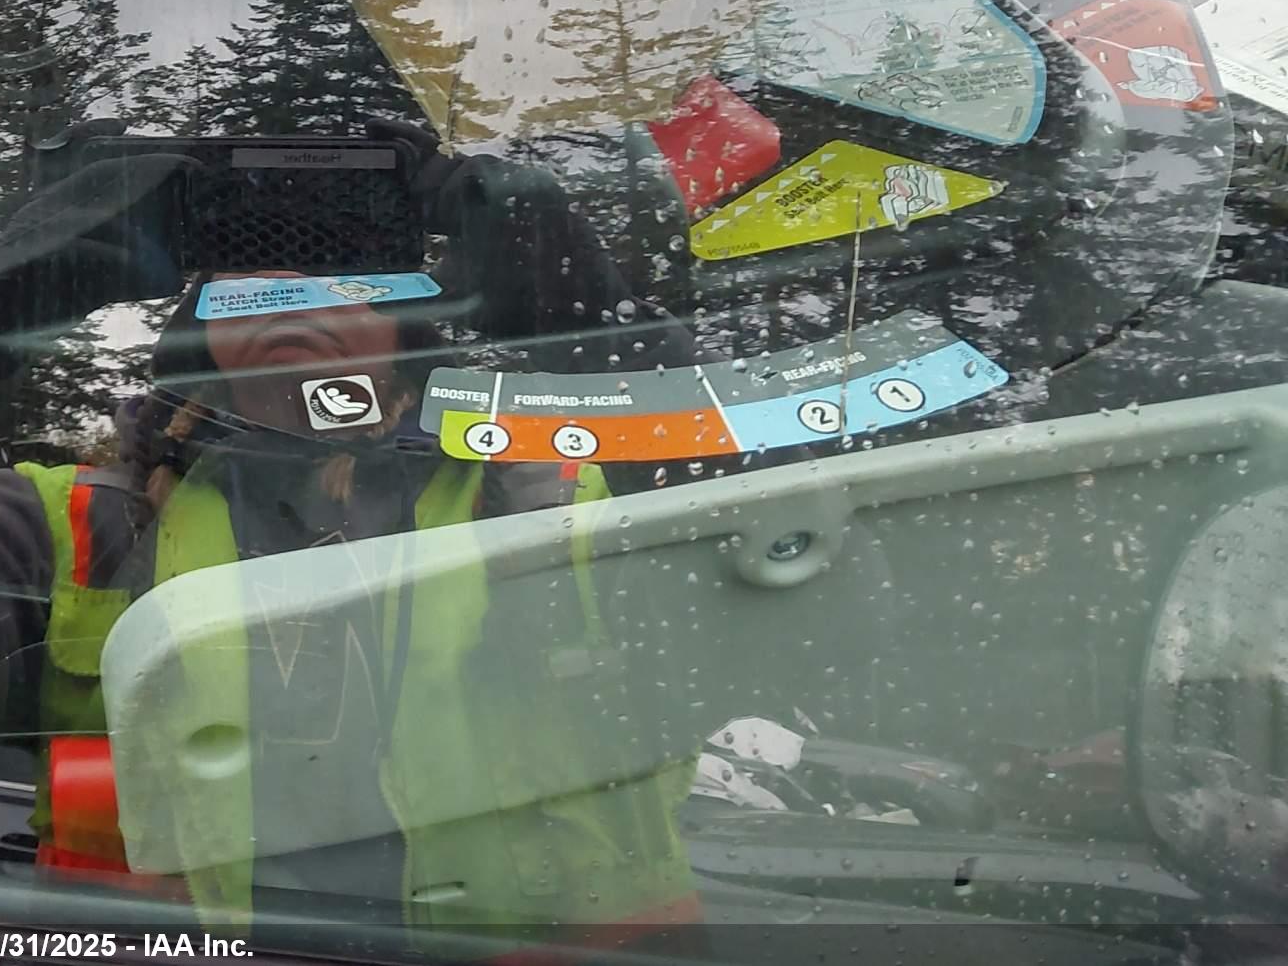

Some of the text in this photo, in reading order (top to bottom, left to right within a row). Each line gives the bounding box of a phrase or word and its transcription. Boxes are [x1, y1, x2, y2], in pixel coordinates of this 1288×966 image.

[209, 287, 305, 302] REAR-FACING
[221, 295, 293, 307] LATCH Strap
[430, 387, 490, 403] BOOSTER
[514, 394, 633, 407] FORWARD-FACING
[889, 386, 911, 403] 1
[811, 406, 833, 425] 2
[479, 430, 494, 447] 4
[568, 433, 583, 451] 3
